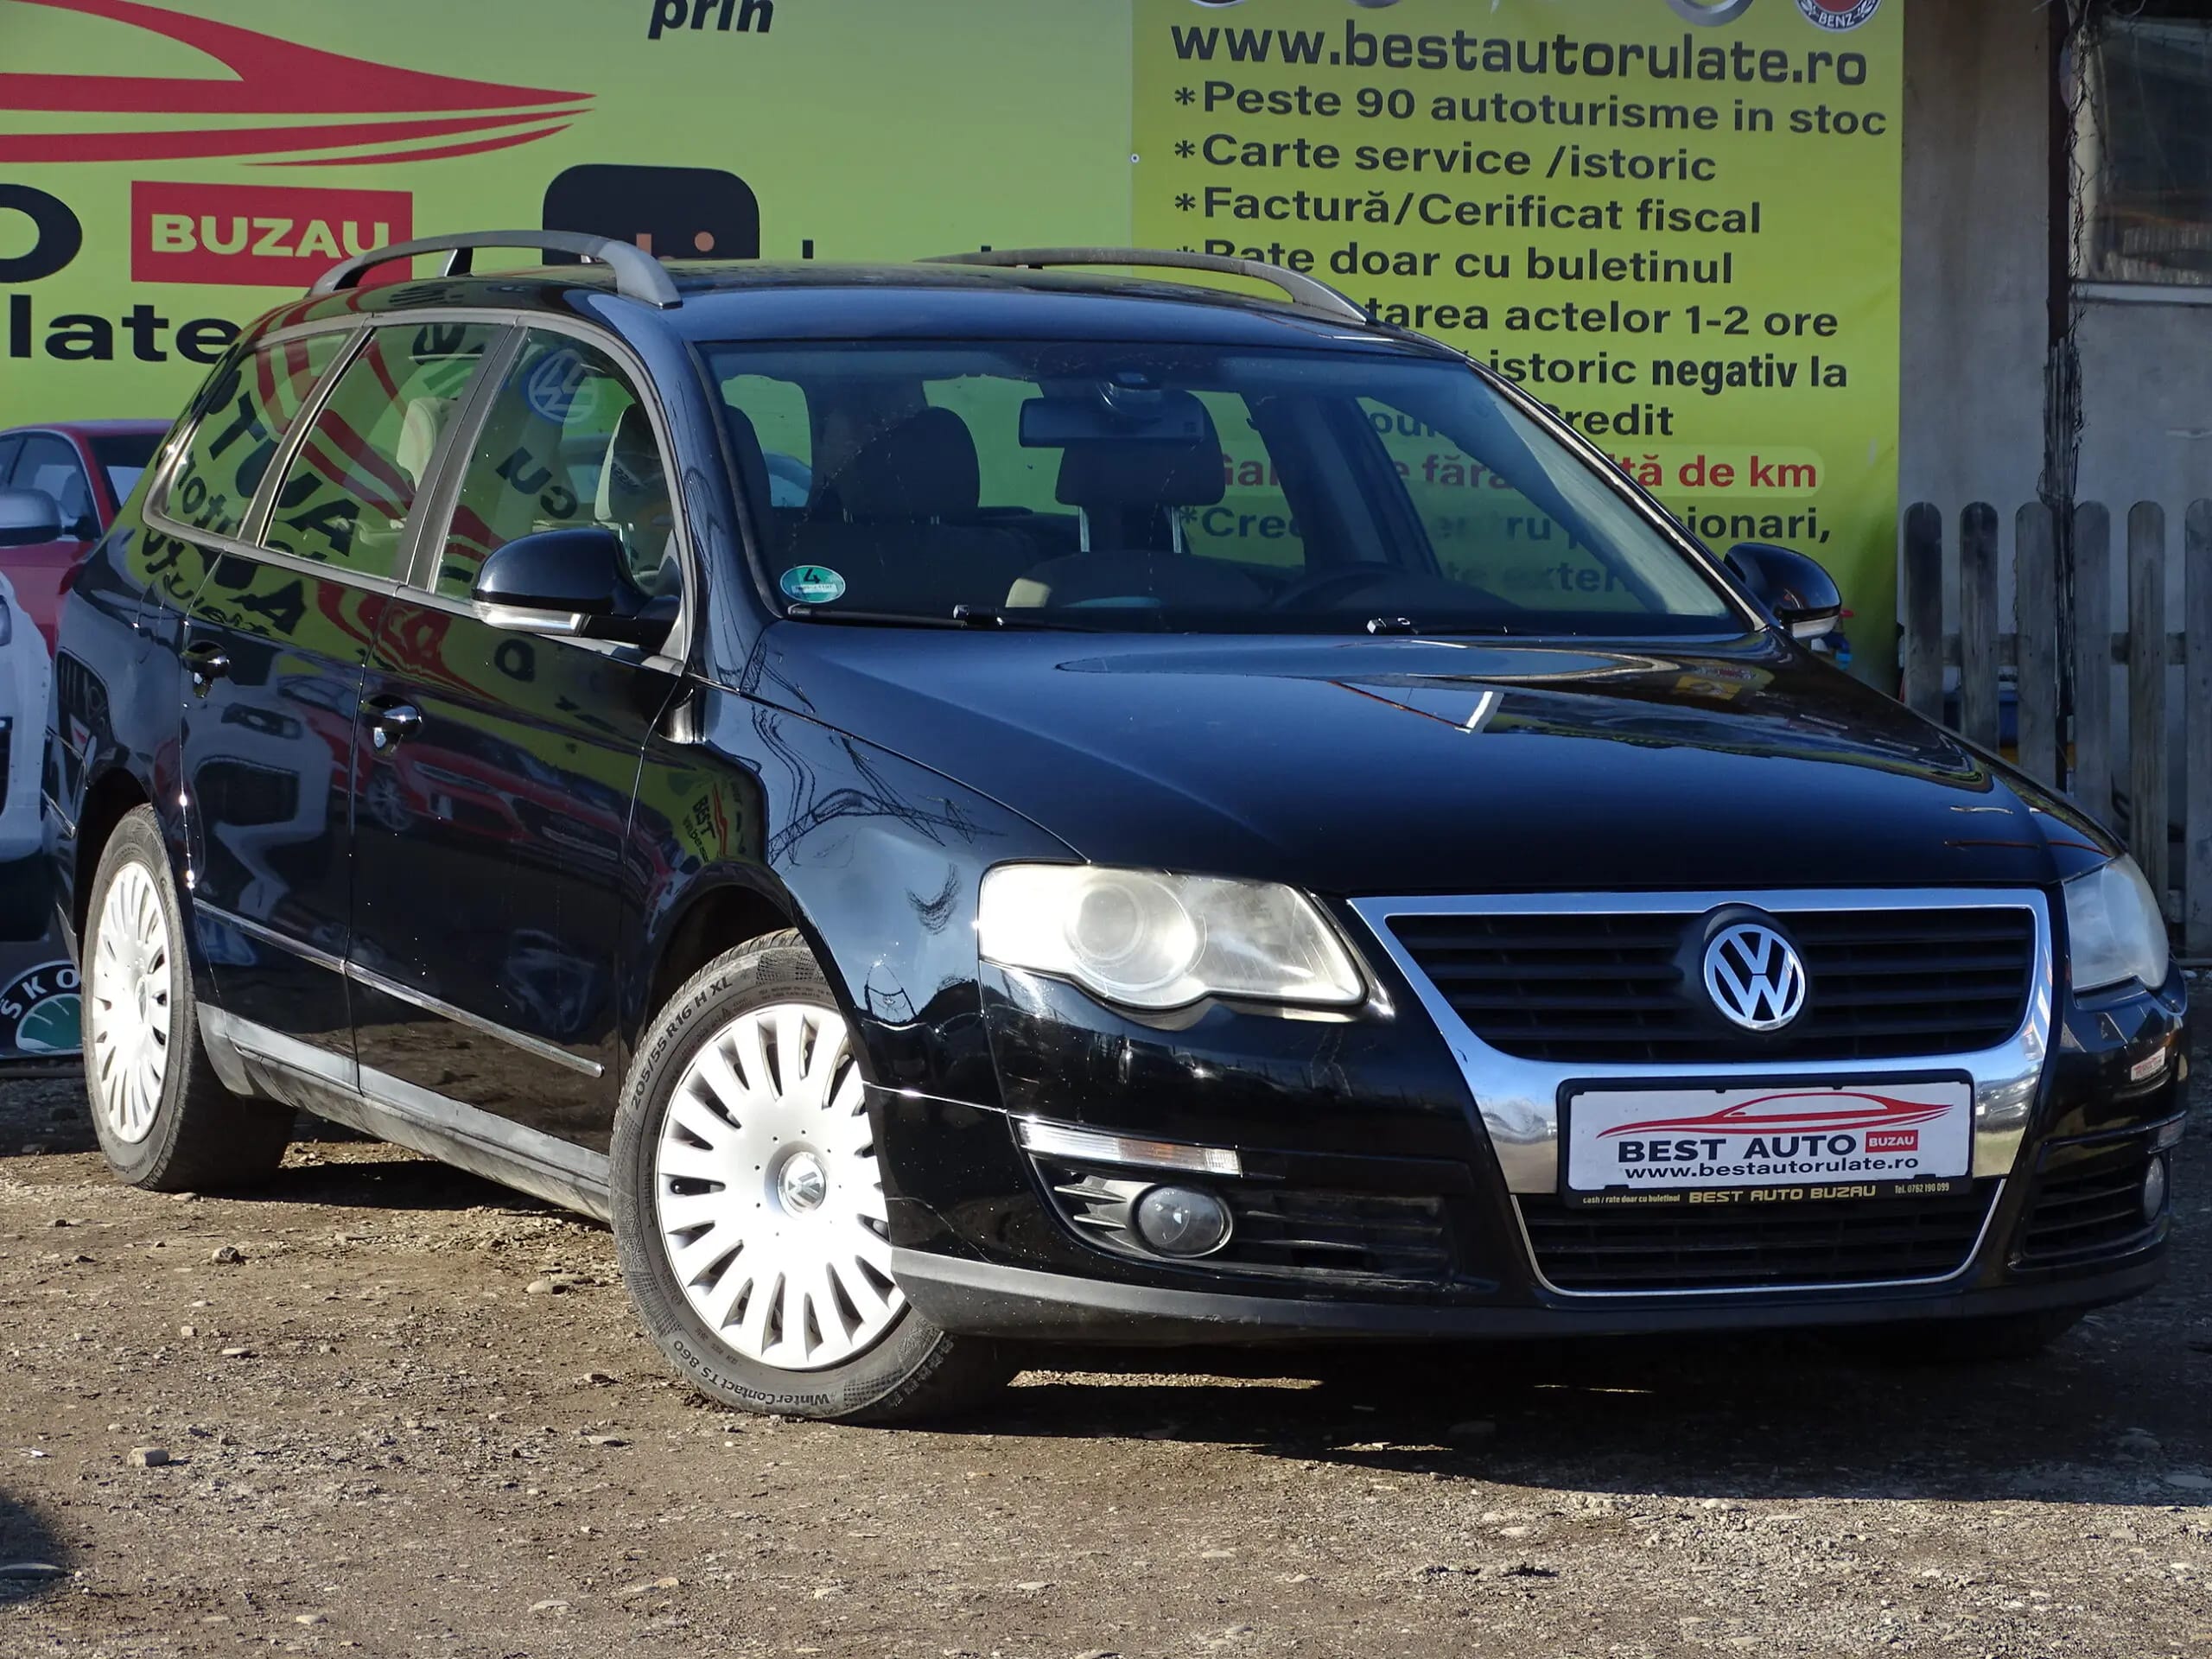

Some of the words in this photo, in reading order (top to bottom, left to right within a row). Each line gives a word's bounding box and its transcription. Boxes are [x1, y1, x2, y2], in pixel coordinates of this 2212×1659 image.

[1819, 11, 1855, 28] BENZ
[1171, 19, 1867, 86] www.bestautorulate.ro
[1356, 87, 1415, 119] 90
[1431, 92, 1719, 130] autoturisme
[1734, 99, 1773, 132] in
[1789, 105, 1886, 136] stoc
[1355, 140, 1531, 175] service
[1545, 144, 1716, 181] /istoric
[1636, 198, 1761, 234] fiscal
[151, 213, 389, 258] BUZAU
[1330, 241, 1440, 276] doar
[1455, 253, 1510, 278] cu
[1527, 246, 1732, 284] buletinul
[1504, 300, 1671, 334] actelor
[1685, 305, 1750, 335] 1-2
[1764, 313, 1838, 337] ore
[1652, 353, 1798, 396] negativ
[1811, 355, 1847, 388] la
[1542, 403, 1674, 435] redit
[1679, 454, 1735, 487] de
[1750, 455, 1816, 488] km
[1678, 506, 1831, 543] ionari,
[631, 1037, 667, 1110] 205/55
[664, 1003, 692, 1039] R16
[694, 990, 709, 1008] H
[709, 976, 734, 996] XL
[1618, 1138, 1726, 1163] BEST
[1744, 1134, 1857, 1160] AUTO
[1868, 1135, 1915, 1147] BUZAU
[1625, 1156, 1919, 1179] www.bestautorulate.ro
[1583, 1195, 1599, 1204] cash
[1605, 1195, 1621, 1204] rate
[1621, 1194, 1637, 1204] doar
[1638, 1195, 1648, 1204] cu
[1648, 1193, 1681, 1204] buletinul
[1689, 1191, 1744, 1204] BEST
[1751, 1188, 1802, 1201] AUTO
[1810, 1185, 1877, 1199] BUZAU
[1894, 1185, 1906, 1194] Tel.
[672, 1339, 701, 1369] 860
[700, 1367, 720, 1387] TS
[720, 1377, 830, 1406] WinterContact
